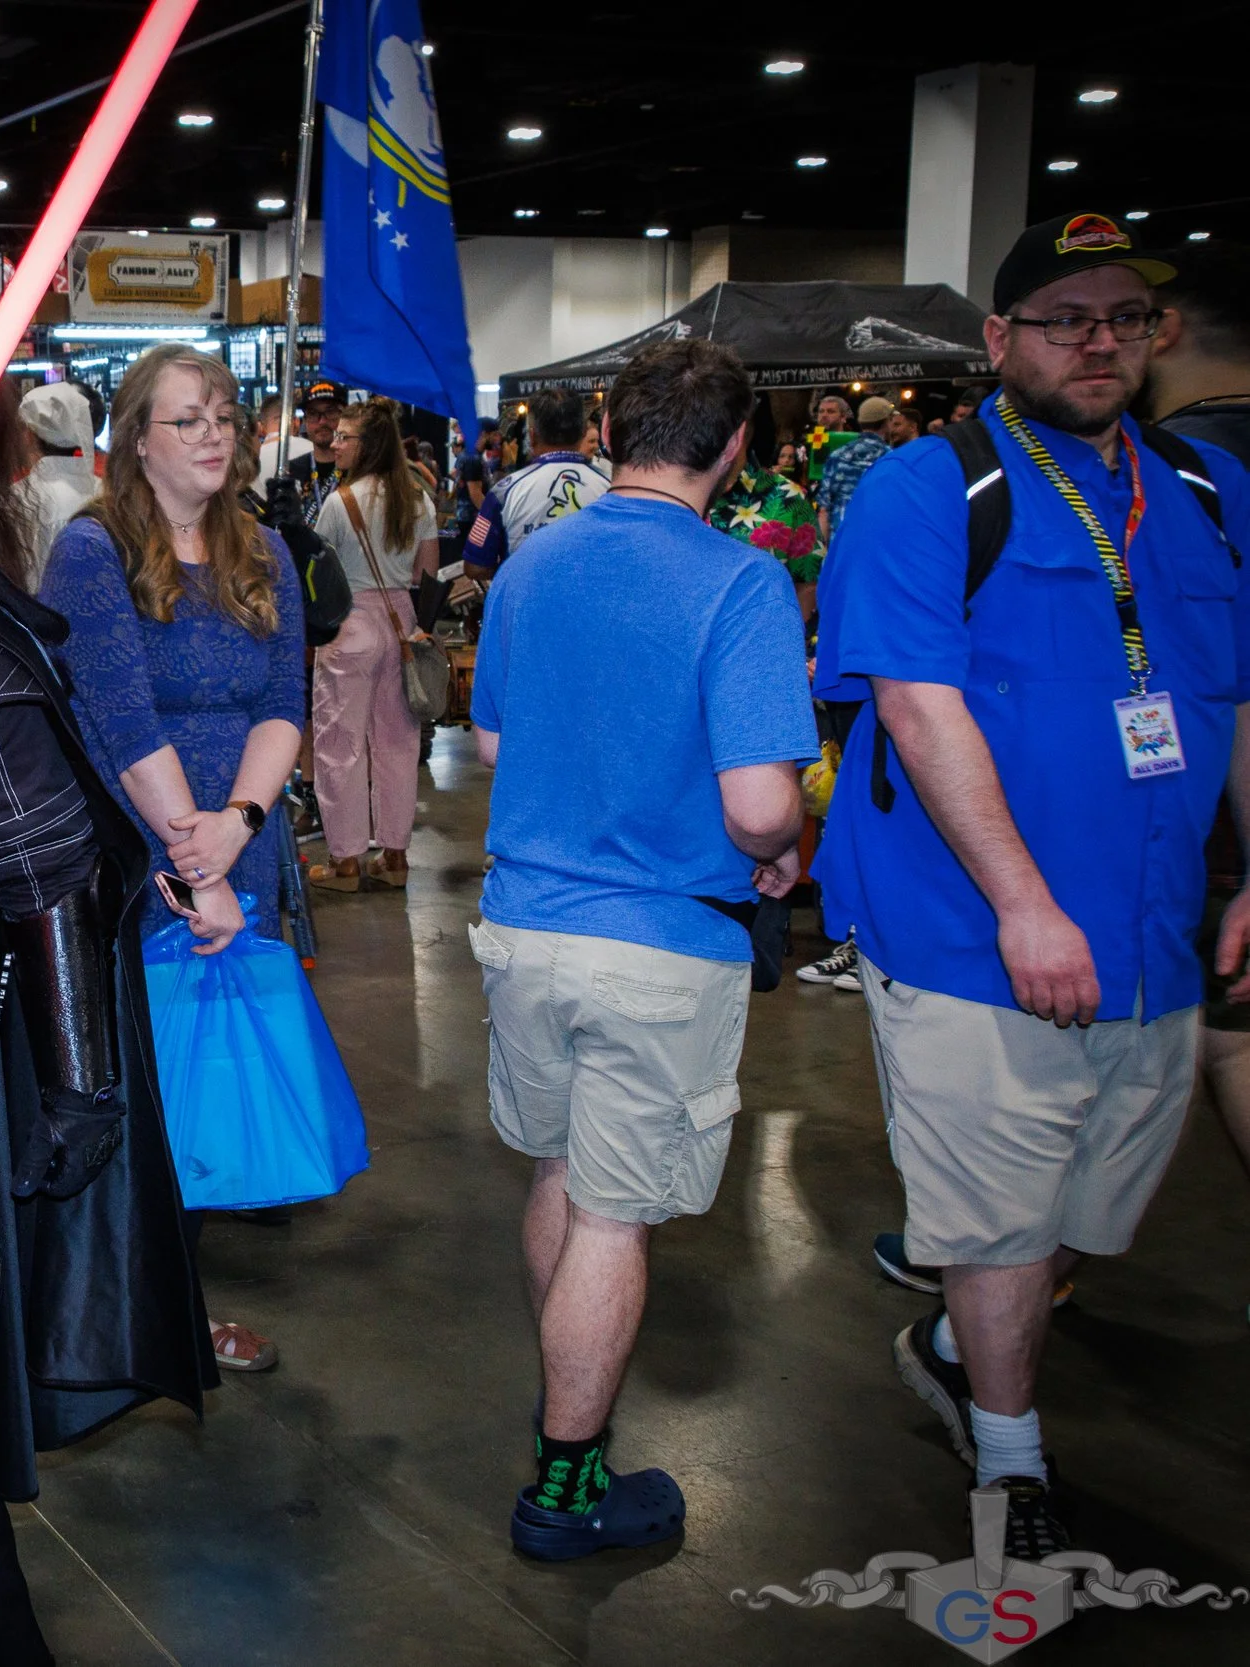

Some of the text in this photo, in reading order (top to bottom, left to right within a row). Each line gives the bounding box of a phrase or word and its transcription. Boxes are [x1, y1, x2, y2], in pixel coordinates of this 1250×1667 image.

[116, 266, 195, 277] FANDOM ALLEY
[1134, 760, 1180, 774] ALL DAYS
